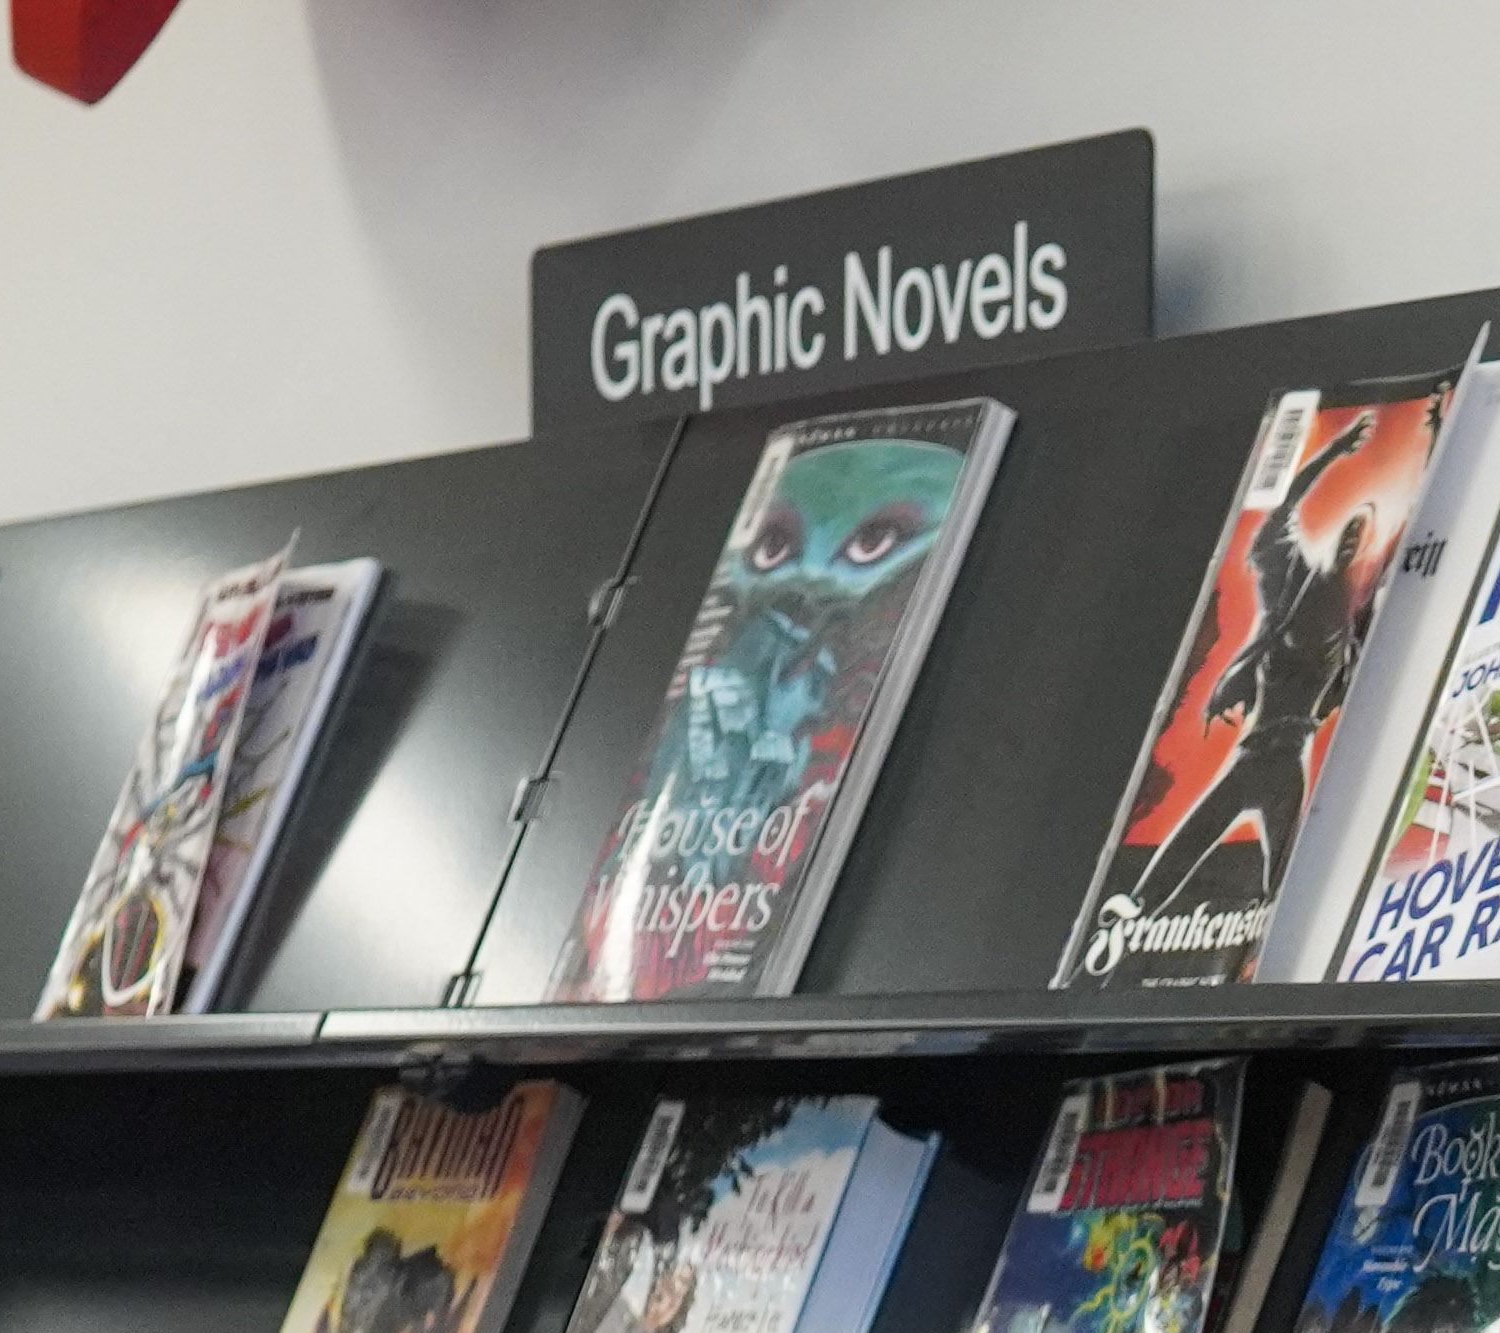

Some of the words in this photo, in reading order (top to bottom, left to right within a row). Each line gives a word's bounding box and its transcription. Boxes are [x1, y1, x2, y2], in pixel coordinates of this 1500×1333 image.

[591, 264, 827, 411] Graphic
[843, 220, 1067, 361] Novels
[757, 799, 810, 875] of
[1349, 915, 1454, 982] CAR
